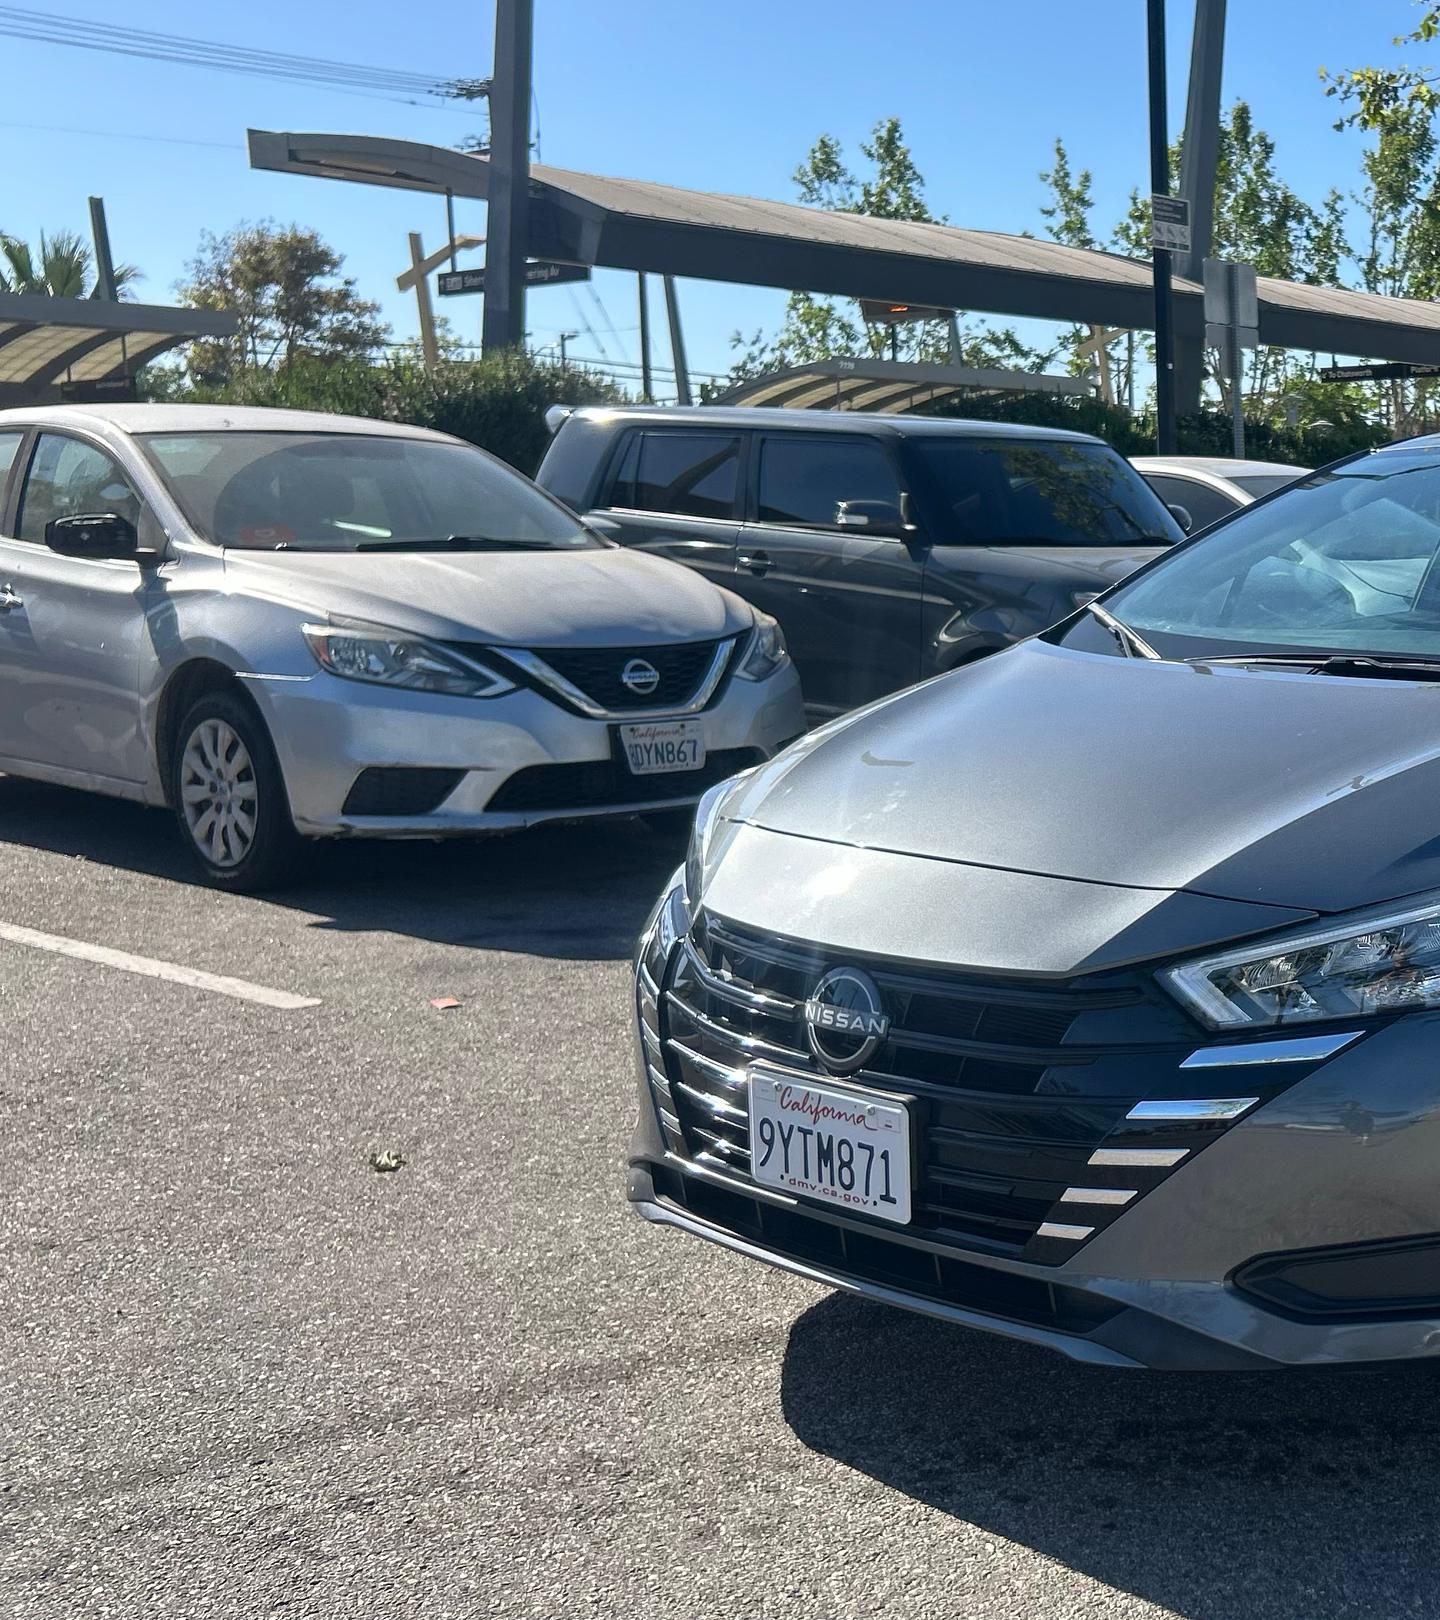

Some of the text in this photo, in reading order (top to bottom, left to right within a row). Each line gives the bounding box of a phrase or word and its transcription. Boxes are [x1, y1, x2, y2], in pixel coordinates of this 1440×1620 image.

[632, 726, 681, 741] California
[805, 1005, 887, 1035] NISSAN
[779, 1085, 879, 1131] California
[758, 1117, 898, 1206] 9YTM871
[788, 1177, 869, 1207] dmv.ca.gov
